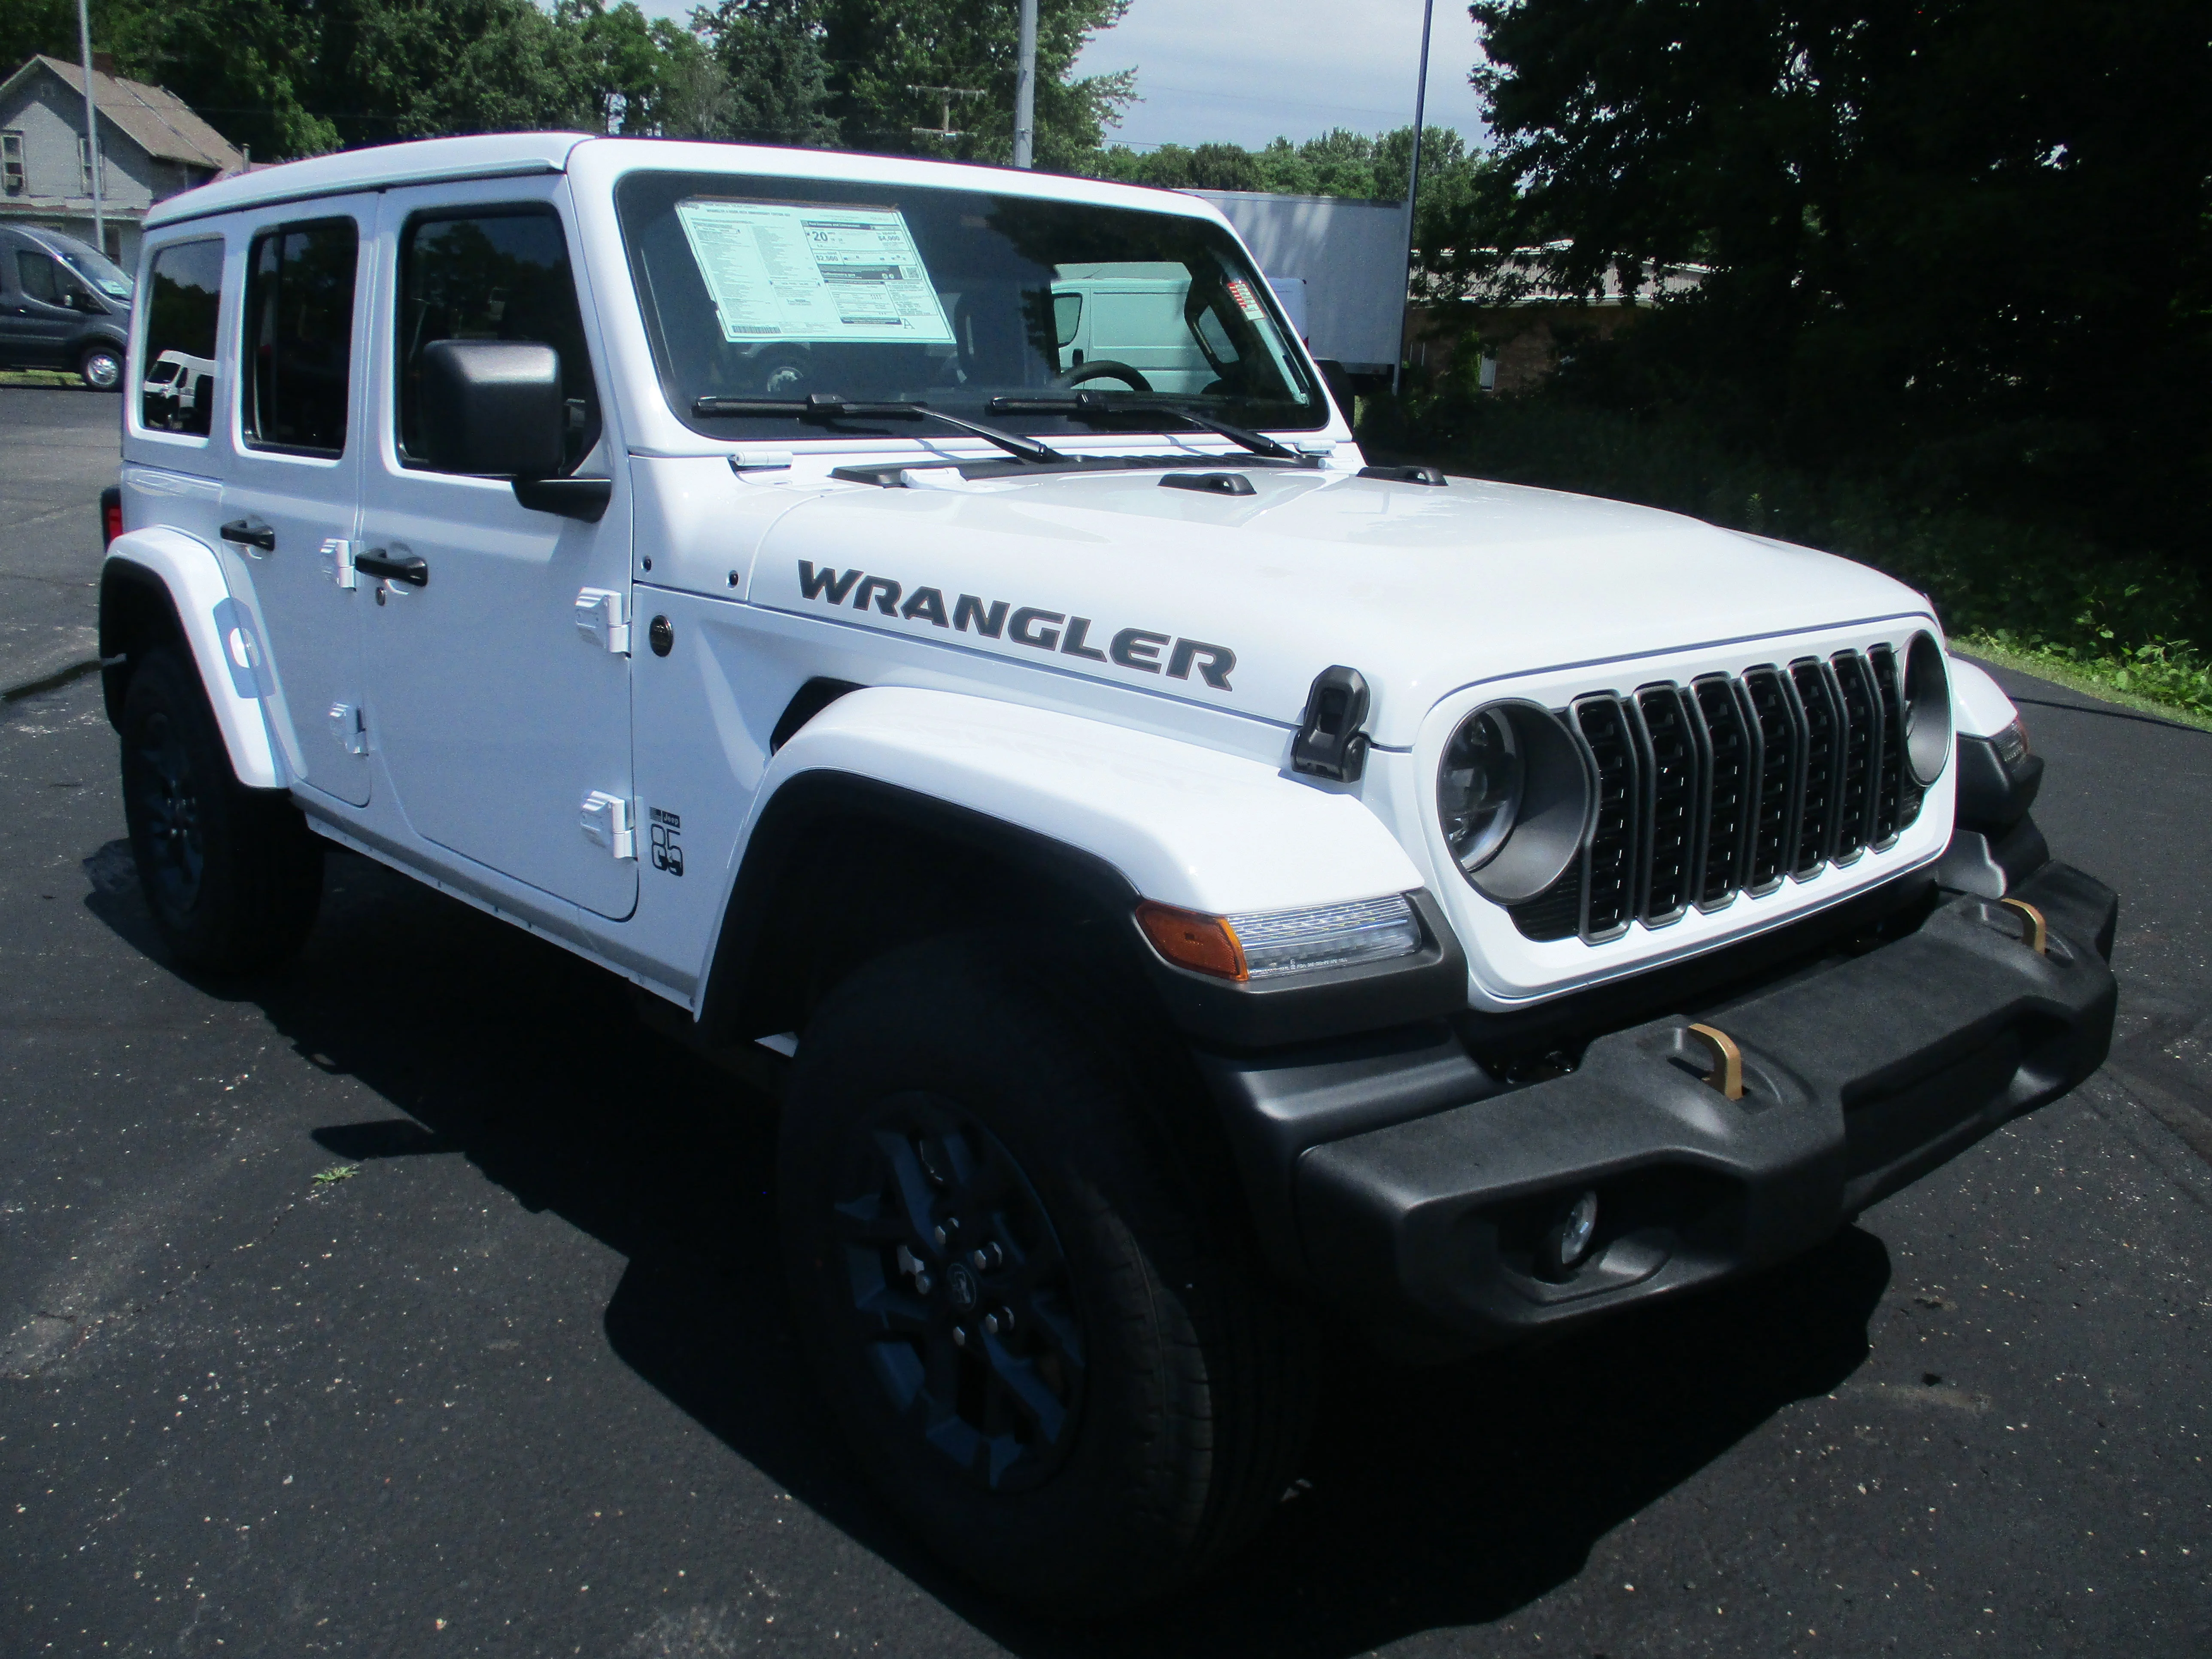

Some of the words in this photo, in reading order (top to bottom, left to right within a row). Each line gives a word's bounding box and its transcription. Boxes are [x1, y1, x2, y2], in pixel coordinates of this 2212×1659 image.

[812, 231, 828, 241] 20
[902, 318, 915, 329] A
[798, 559, 1237, 691] WRANGLER
[664, 813, 679, 825] Jeep
[651, 823, 684, 877] 85
